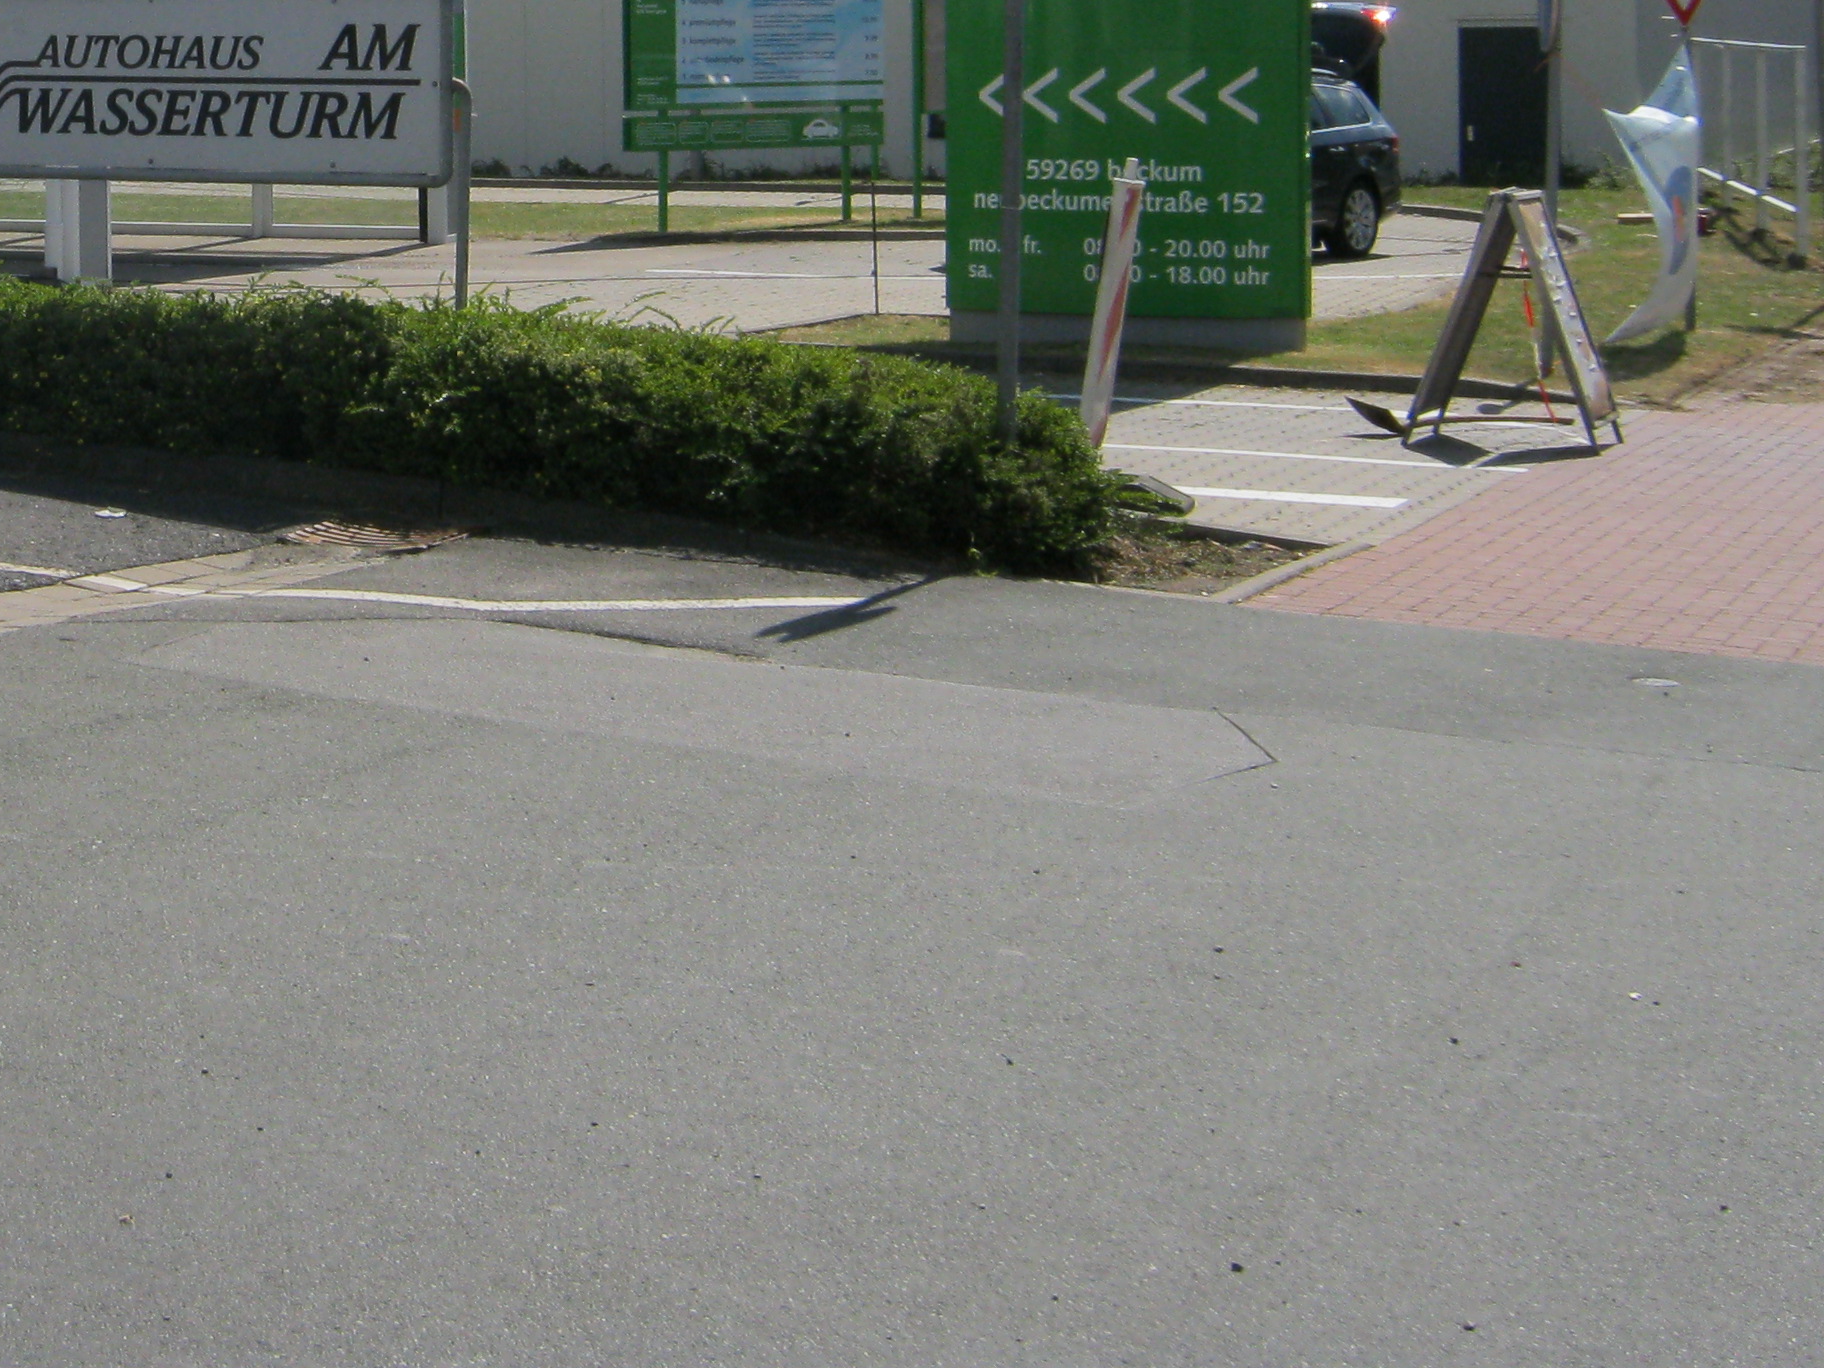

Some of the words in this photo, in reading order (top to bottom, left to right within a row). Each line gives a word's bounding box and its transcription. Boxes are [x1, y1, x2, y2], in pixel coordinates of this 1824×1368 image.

[36, 34, 264, 71] AUTOHAUS
[320, 23, 422, 72] AM
[15, 88, 406, 141] WASSERTURM
[1026, 158, 1101, 181] 59269
[1107, 158, 1204, 181] bckum
[1142, 190, 1209, 213] traße
[1217, 192, 1265, 214] 152
[969, 238, 1001, 253] mo.
[1023, 235, 1042, 254] fr.
[1164, 239, 1227, 259] 20.00
[1234, 237, 1271, 259] uhr
[968, 263, 994, 278] sa.
[1166, 265, 1227, 285] 18.00
[1234, 264, 1271, 285] uhr
